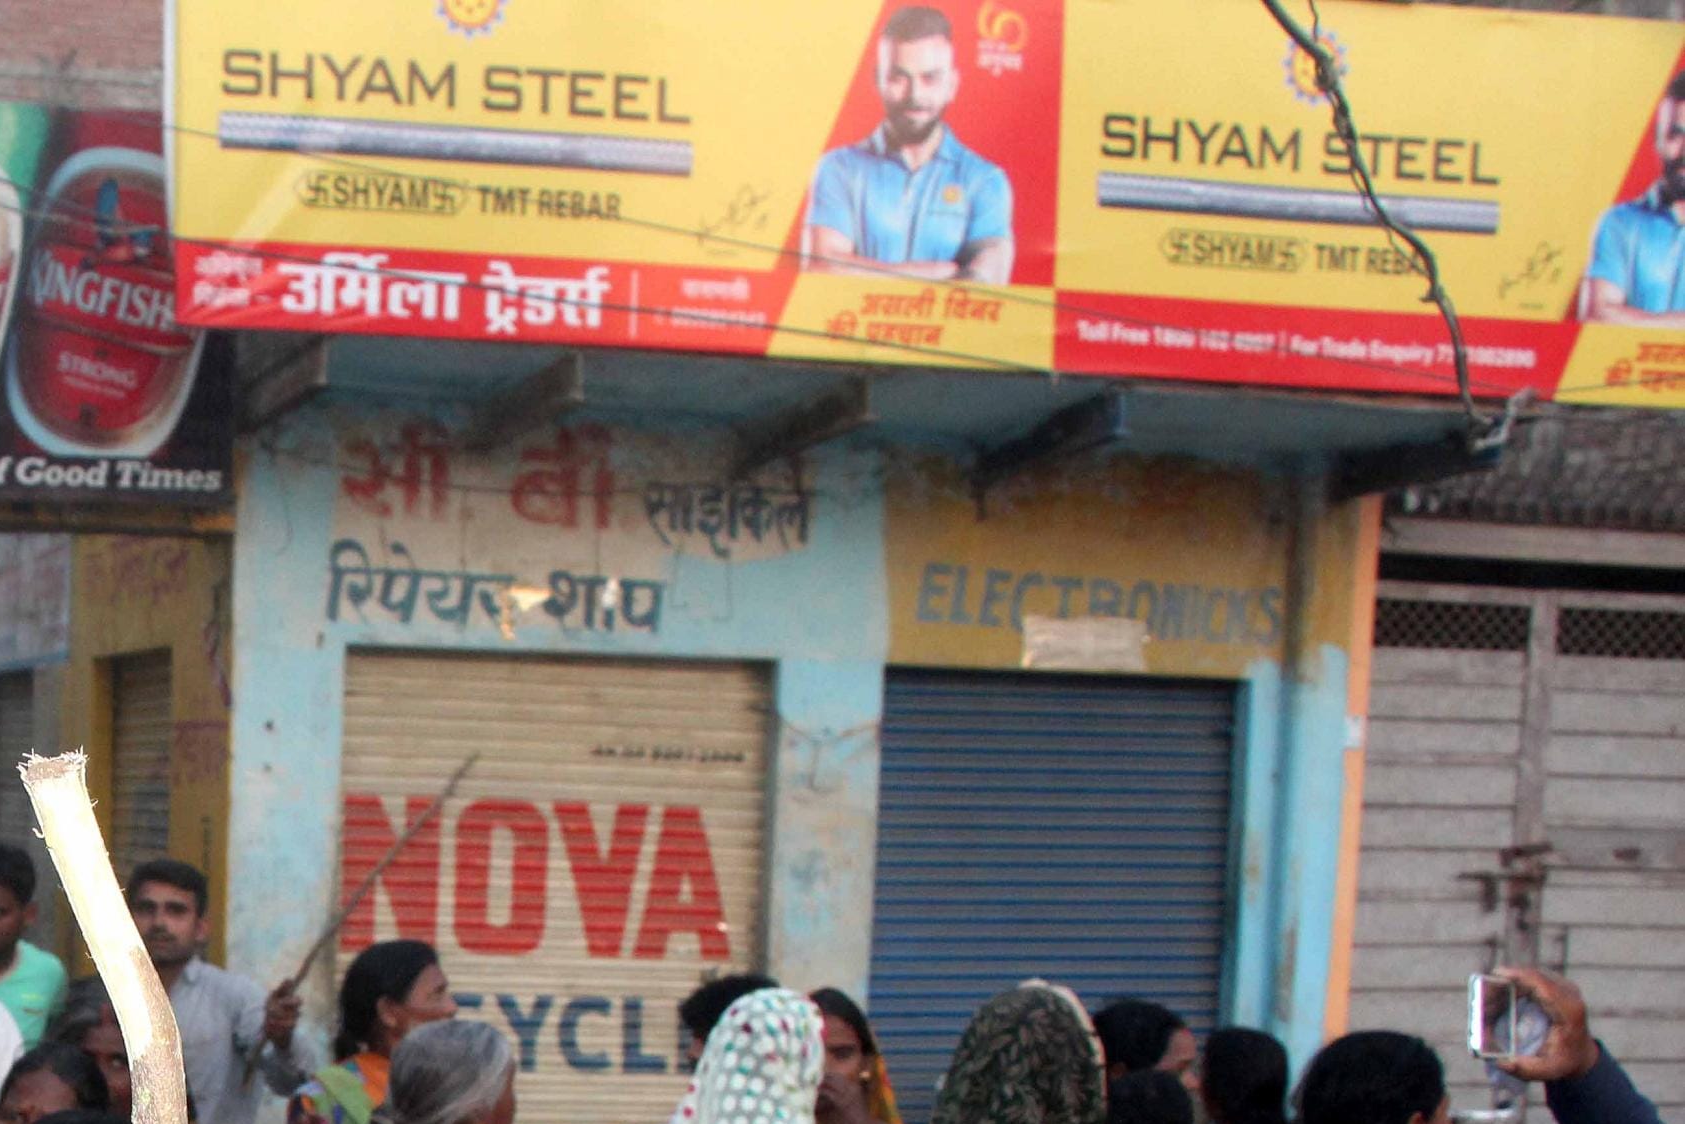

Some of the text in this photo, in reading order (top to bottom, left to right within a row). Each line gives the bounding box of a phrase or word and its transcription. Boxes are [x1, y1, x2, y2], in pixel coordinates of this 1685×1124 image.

[221, 48, 692, 125] SHYAM STEEL
[1101, 113, 1501, 186] SHYAM STEEL
[334, 175, 623, 220] SHYAM TMT REBAR
[29, 249, 177, 335] KINGFISH
[277, 252, 468, 321] उर्मिला
[481, 260, 612, 335] ट्रेडर्स
[1193, 234, 1433, 276] SHYAM TMT REBA
[15, 457, 109, 489] Good
[116, 459, 223, 490] Times
[340, 794, 731, 959] NOVA
[452, 992, 698, 1073] YCL
